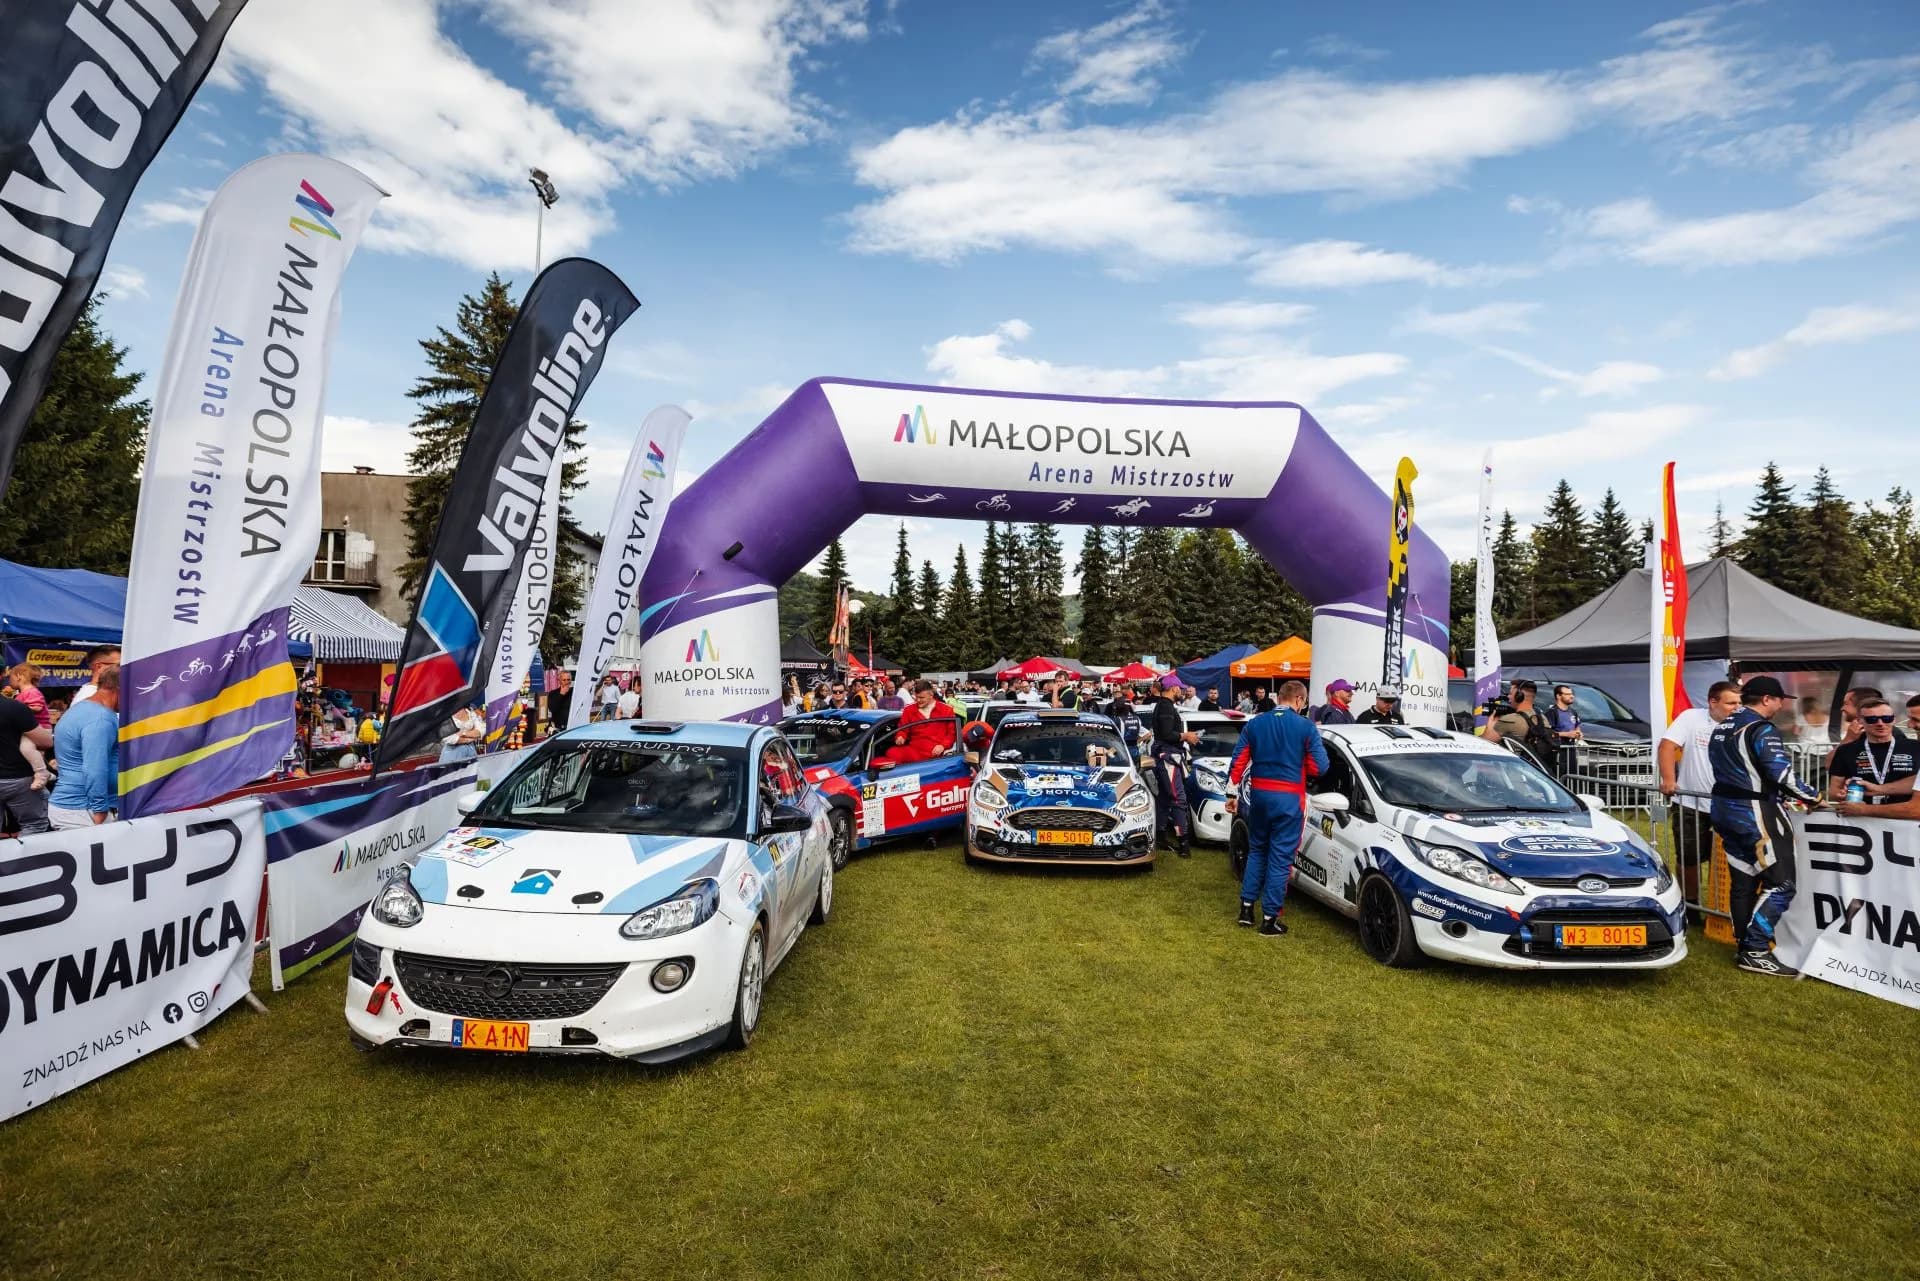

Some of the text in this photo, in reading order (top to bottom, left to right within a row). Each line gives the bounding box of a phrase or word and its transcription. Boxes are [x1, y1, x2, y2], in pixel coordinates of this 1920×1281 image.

[240, 243, 318, 558] MAŁOPOLSKA
[462, 299, 606, 572] Valvoline
[948, 418, 1191, 458] MAŁOPOLSKA
[173, 326, 244, 625] Arena Mistrzostw
[1028, 461, 1234, 488] Arena Mistrzostw
[654, 667, 755, 684] MAŁOPOLSKA
[684, 686, 770, 697] Arena Mistrzostw
[1355, 681, 1444, 698] MAPOLSKA
[863, 786, 876, 799] 32
[354, 825, 426, 867] MAŁOPOLSKA
[1038, 831, 1052, 842] W8
[0, 818, 243, 936] BYD
[1417, 889, 1492, 920] www.fordserwis.com.pl
[1566, 928, 1588, 944] W3
[1603, 926, 1643, 944] 801S
[1813, 892, 1920, 953] DYNA
[0, 900, 247, 1036] YNAMICA
[464, 1023, 478, 1045] K
[485, 1025, 526, 1048] A1N
[22, 1020, 152, 1089] ZNAJDŹ NAS NA
